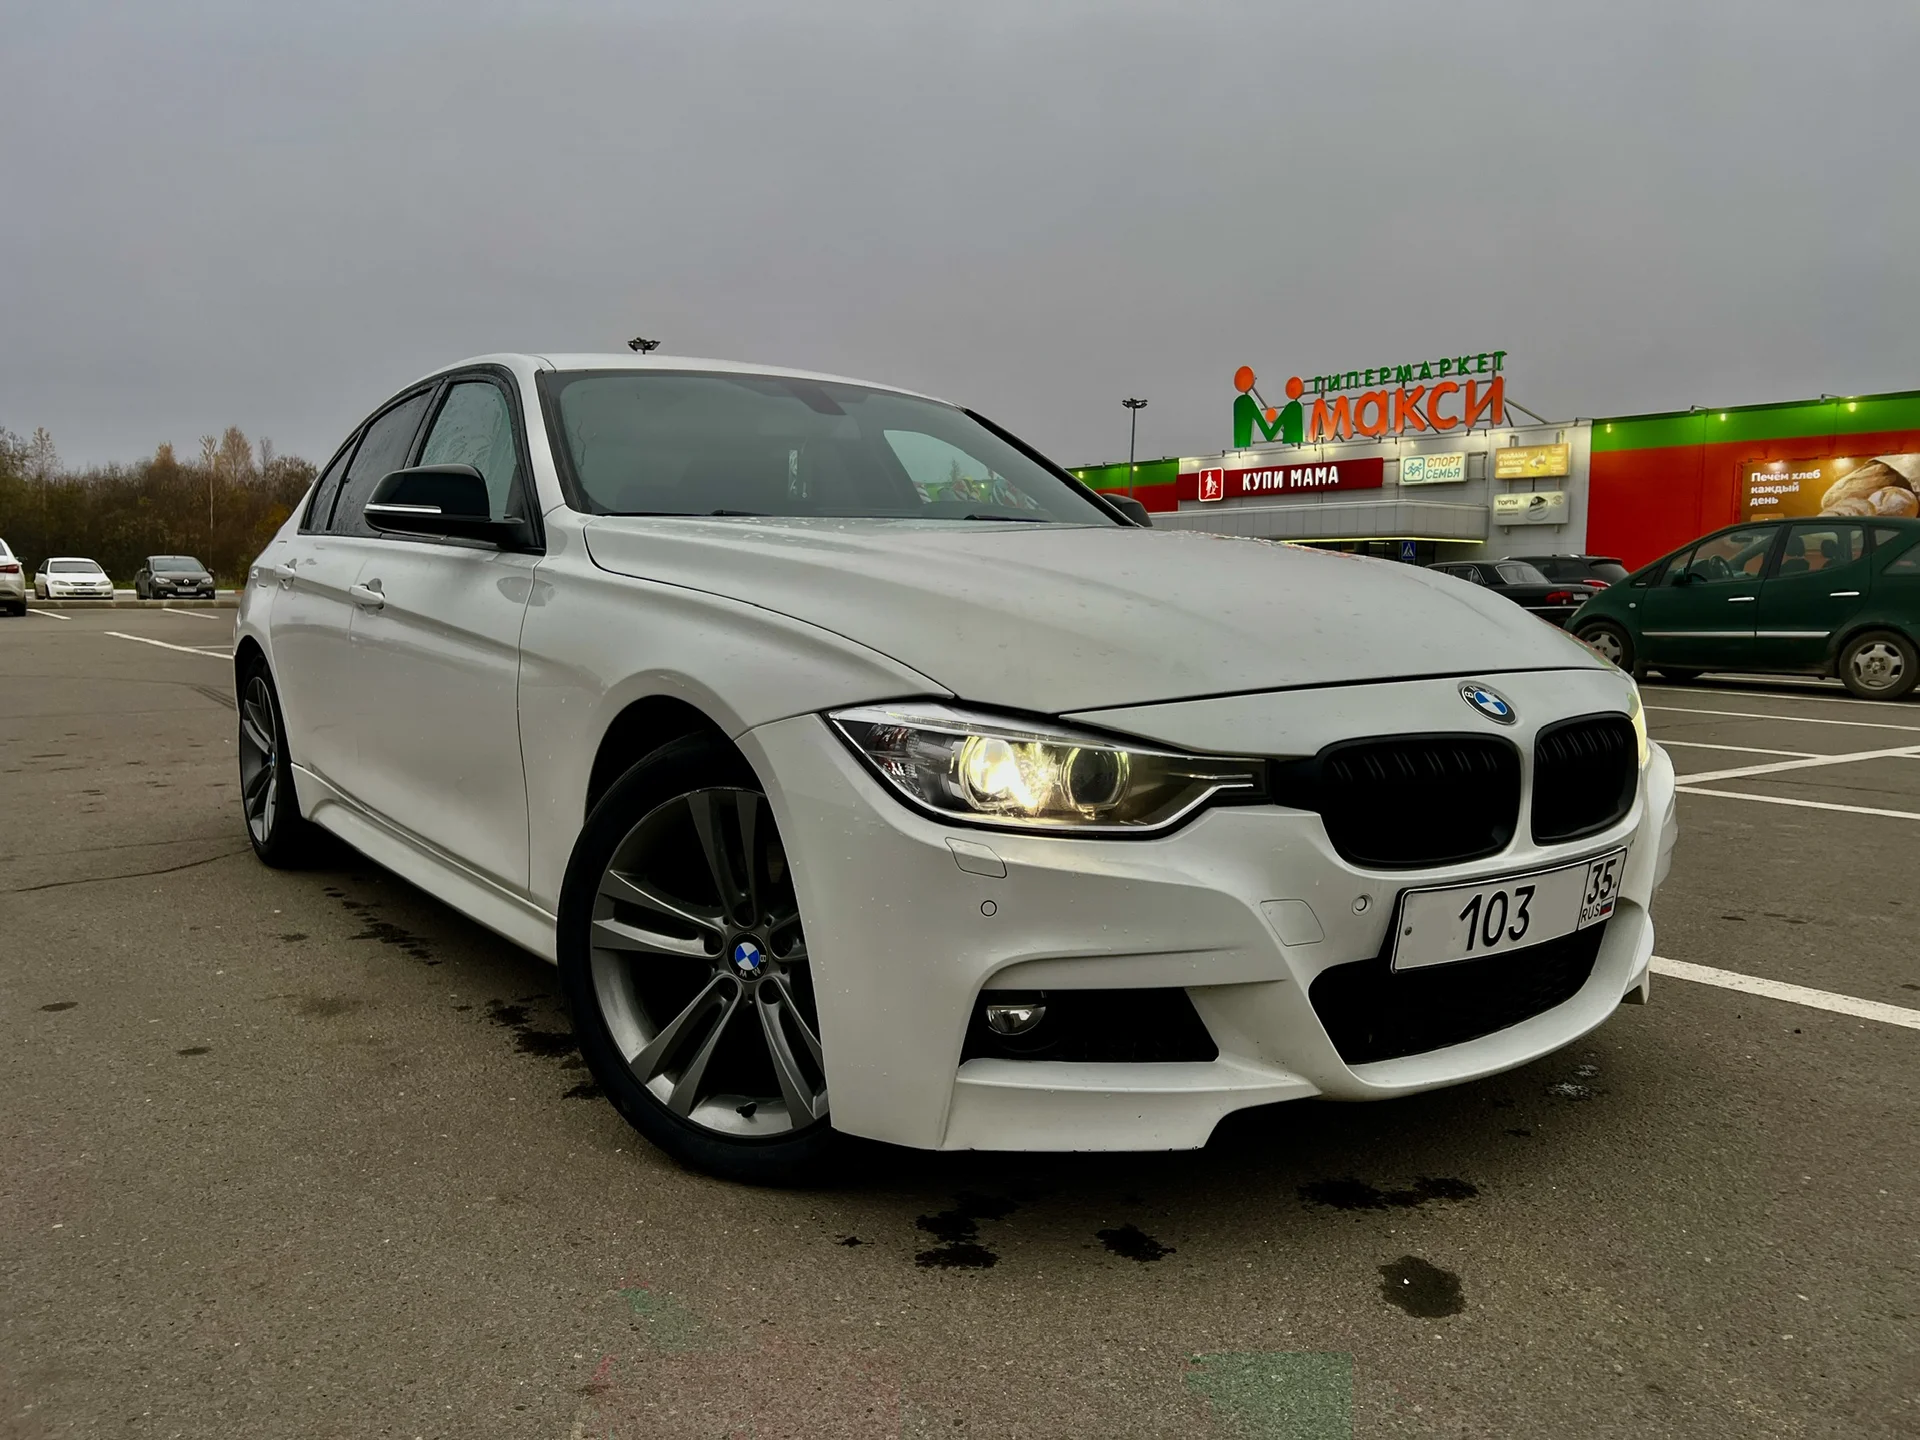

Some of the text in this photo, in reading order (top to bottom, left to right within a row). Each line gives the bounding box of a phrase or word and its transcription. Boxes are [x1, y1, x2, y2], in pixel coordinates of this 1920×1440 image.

[1314, 350, 1507, 394] ГИПЕРМАРКЕТ
[1427, 456, 1462, 468] СПОРТ
[1242, 466, 1339, 491] КУПИ МАМА
[1426, 468, 1461, 479] СЕМЬЯ
[1751, 469, 1821, 482] Печём хлеб
[1750, 482, 1800, 494] каждый
[1750, 496, 1779, 507] день
[1586, 858, 1617, 905] 35
[1459, 885, 1536, 952] 103
[1581, 901, 1601, 924] RUS
